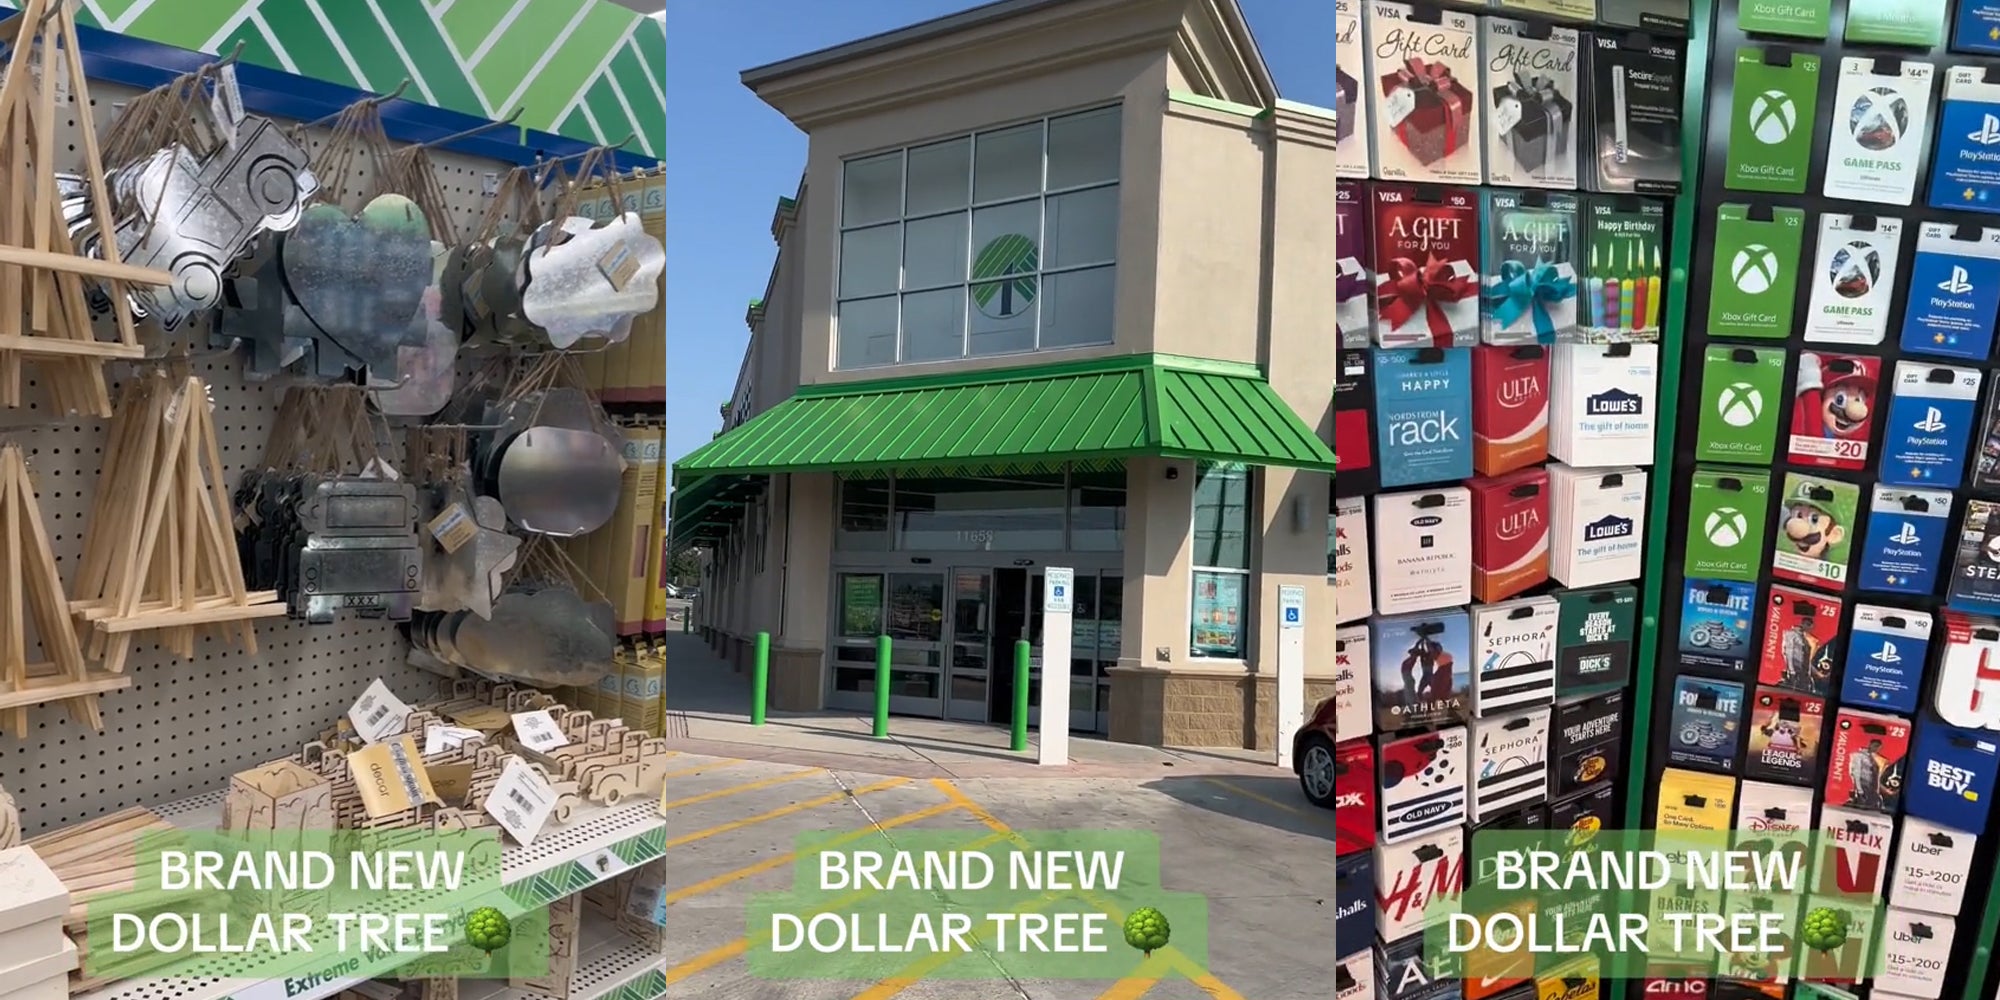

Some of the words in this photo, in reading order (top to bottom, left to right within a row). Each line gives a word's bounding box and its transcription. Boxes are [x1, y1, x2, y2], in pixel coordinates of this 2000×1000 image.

[1376, 6, 1400, 19] VISA
[1754, 4, 1775, 14] Xbox
[1777, 5, 1793, 17] Gift
[1795, 7, 1815, 18] Card
[1492, 22, 1513, 35] VISA
[1424, 33, 1472, 59] Card
[1597, 37, 1617, 49] VISA
[1532, 48, 1575, 73] Card
[1803, 62, 1816, 72] $25
[1852, 63, 1859, 72] 3
[1740, 163, 1759, 174] Xbox
[1761, 165, 1776, 175] Gift
[1776, 166, 1794, 176] Card
[1844, 158, 1876, 170] GAME
[1877, 160, 1902, 171] PASS
[1379, 192, 1402, 203] VISA
[1495, 198, 1515, 208] VISA
[1595, 206, 1612, 215] VISA
[1597, 220, 1622, 232] Happy
[1624, 221, 1655, 232] Birthday
[1785, 216, 1798, 226] $25
[1389, 216, 1408, 238] A
[1412, 216, 1462, 251] GIFT
[1503, 219, 1518, 241] A
[1397, 241, 1418, 249] FOR
[1431, 241, 1450, 250] YOU
[1510, 244, 1528, 252] FOR
[1540, 244, 1556, 252] YOU
[1930, 298, 1975, 310] PlayStation
[1722, 312, 1741, 322] Xbox
[1743, 313, 1757, 323] Gift
[1759, 314, 1776, 323] Card
[1823, 306, 1850, 315] GAME
[1851, 306, 1873, 316] PASS
[1769, 358, 1781, 367] $50
[1402, 379, 1450, 391] HAPPY
[1503, 376, 1540, 401] ULTA
[1963, 378, 1976, 386] $25
[1592, 398, 1637, 413] LOWE'S
[1389, 411, 1439, 421] NORDSTROM
[1389, 410, 1460, 446] rack
[1579, 422, 1595, 431] The
[1597, 422, 1613, 433] gift
[1614, 422, 1624, 430] of
[1624, 422, 1649, 430] home
[1709, 441, 1728, 449] Xbox
[1729, 442, 1743, 451] Gift
[1744, 443, 1761, 452] Card
[1906, 436, 1948, 447] PlayStation
[1834, 441, 1862, 458] $20
[1753, 485, 1765, 494] $50
[1935, 497, 1948, 505] $50
[1502, 508, 1540, 534] ULTA
[1589, 522, 1628, 538] LOWE'S
[1577, 548, 1592, 557] The
[1593, 545, 1607, 557] gift
[1608, 543, 1616, 552] of
[1617, 541, 1638, 550] home
[1883, 547, 1922, 558] PlayStation
[1397, 556, 1426, 565] BANANA
[1696, 560, 1715, 568] Xbox
[1716, 561, 1729, 569] Gift
[1730, 562, 1748, 570] Card
[1818, 563, 1840, 579] $10
[1588, 611, 1610, 620] EVERY
[1821, 605, 1836, 617] $25
[1580, 624, 1607, 637] STARTS
[1607, 624, 1616, 633] AT
[1915, 620, 1928, 628] $50
[1489, 632, 1546, 647] SEPHORA
[1765, 606, 1781, 661] VALORANT
[1580, 657, 1610, 670] DICK'S
[1865, 663, 1904, 676] PlayStation
[1402, 699, 1461, 715] ATHLETA
[1806, 702, 1822, 713] $25
[1563, 724, 1581, 738] YOUR
[1582, 712, 1619, 731] ADVENTURE
[1570, 728, 1594, 744] STARTS
[1595, 723, 1611, 736] HERE
[1889, 727, 1905, 737] $25
[1485, 735, 1539, 756] SEPHORA
[1762, 748, 1796, 761] LEAGUE
[1832, 730, 1849, 783] VALORANT
[1761, 756, 1802, 769] LEGENDS
[1927, 759, 1975, 784] BEST
[370, 763, 390, 796] decor
[1928, 774, 1968, 795] BUY
[1406, 809, 1424, 821] OLD
[1424, 803, 1446, 816] NAVY
[1672, 820, 1690, 830] Many
[1691, 823, 1714, 832] Options
[1827, 825, 1883, 850] NETFLIX
[1911, 842, 1942, 857] Uber
[1376, 854, 1463, 921] H&M
[1657, 896, 1709, 914] BARNES
[1893, 930, 1923, 945] Uber
[284, 956, 360, 998] Extreme
